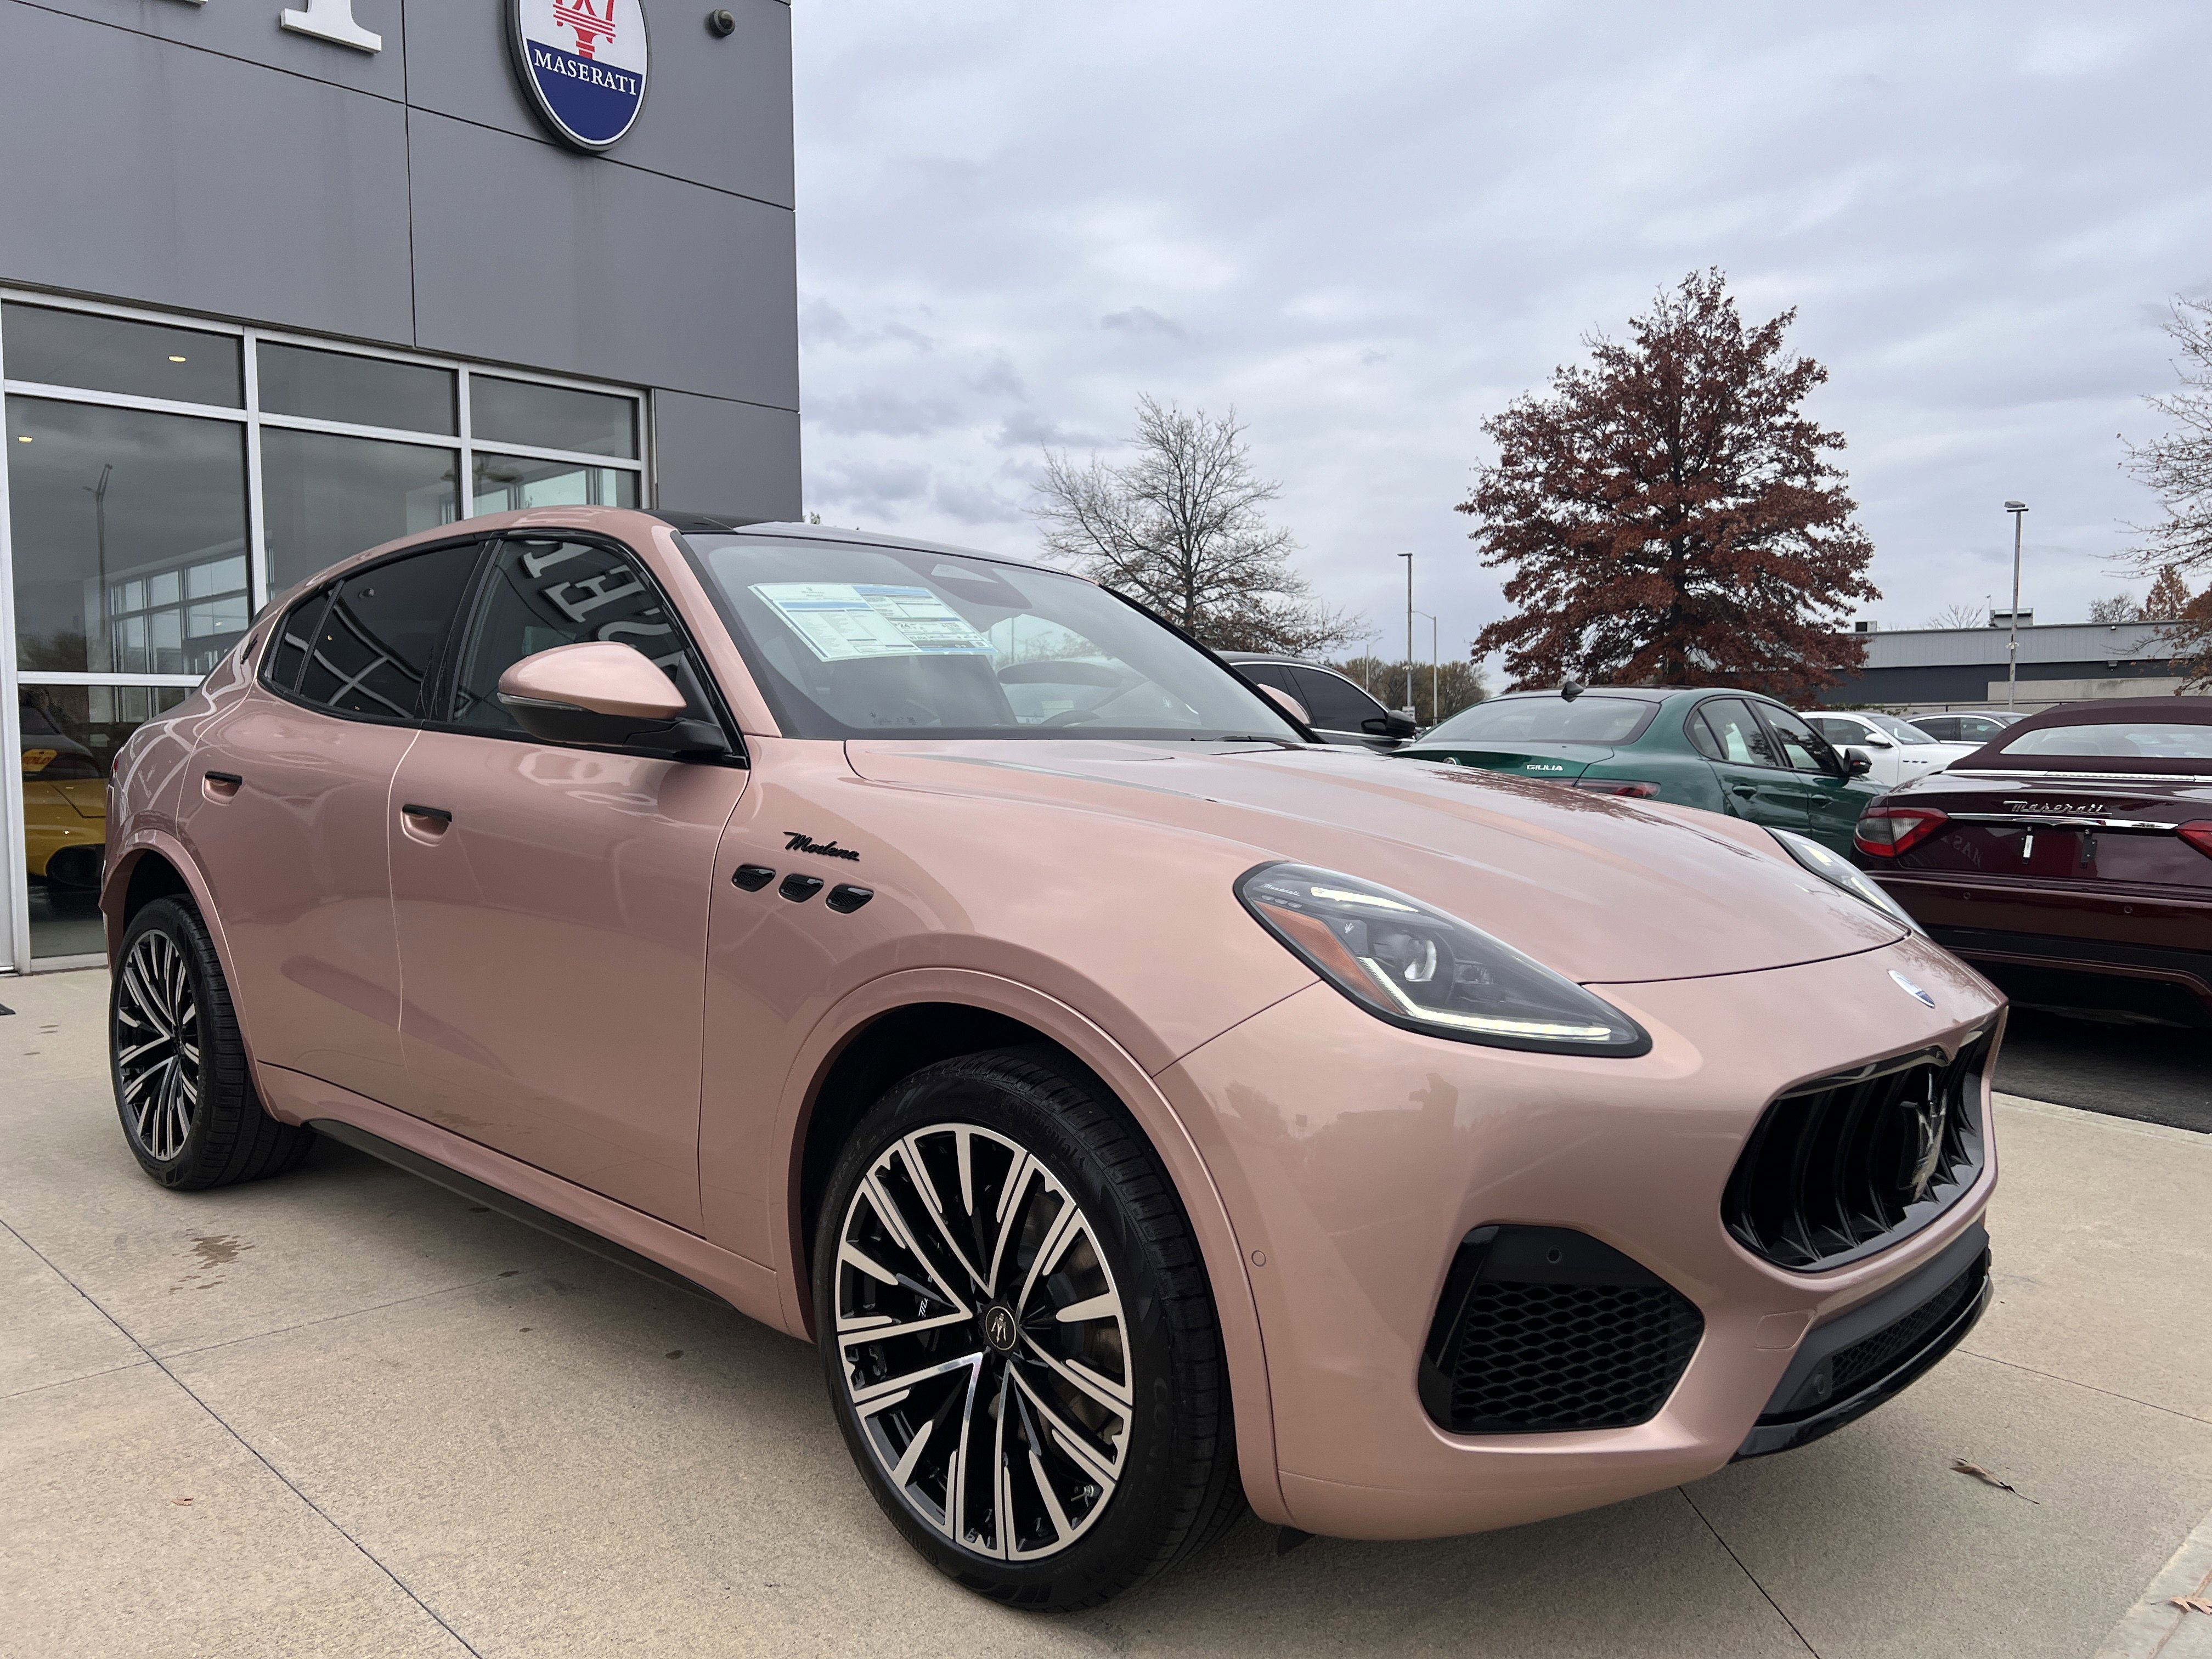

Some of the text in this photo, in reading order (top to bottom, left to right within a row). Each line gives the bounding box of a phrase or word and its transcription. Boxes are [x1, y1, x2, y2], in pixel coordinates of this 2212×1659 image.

[534, 49, 637, 95] MASERATI
[2003, 800, 2112, 815] Maserati
[783, 831, 860, 862] Modena
[1263, 883, 1301, 896] Maserati
